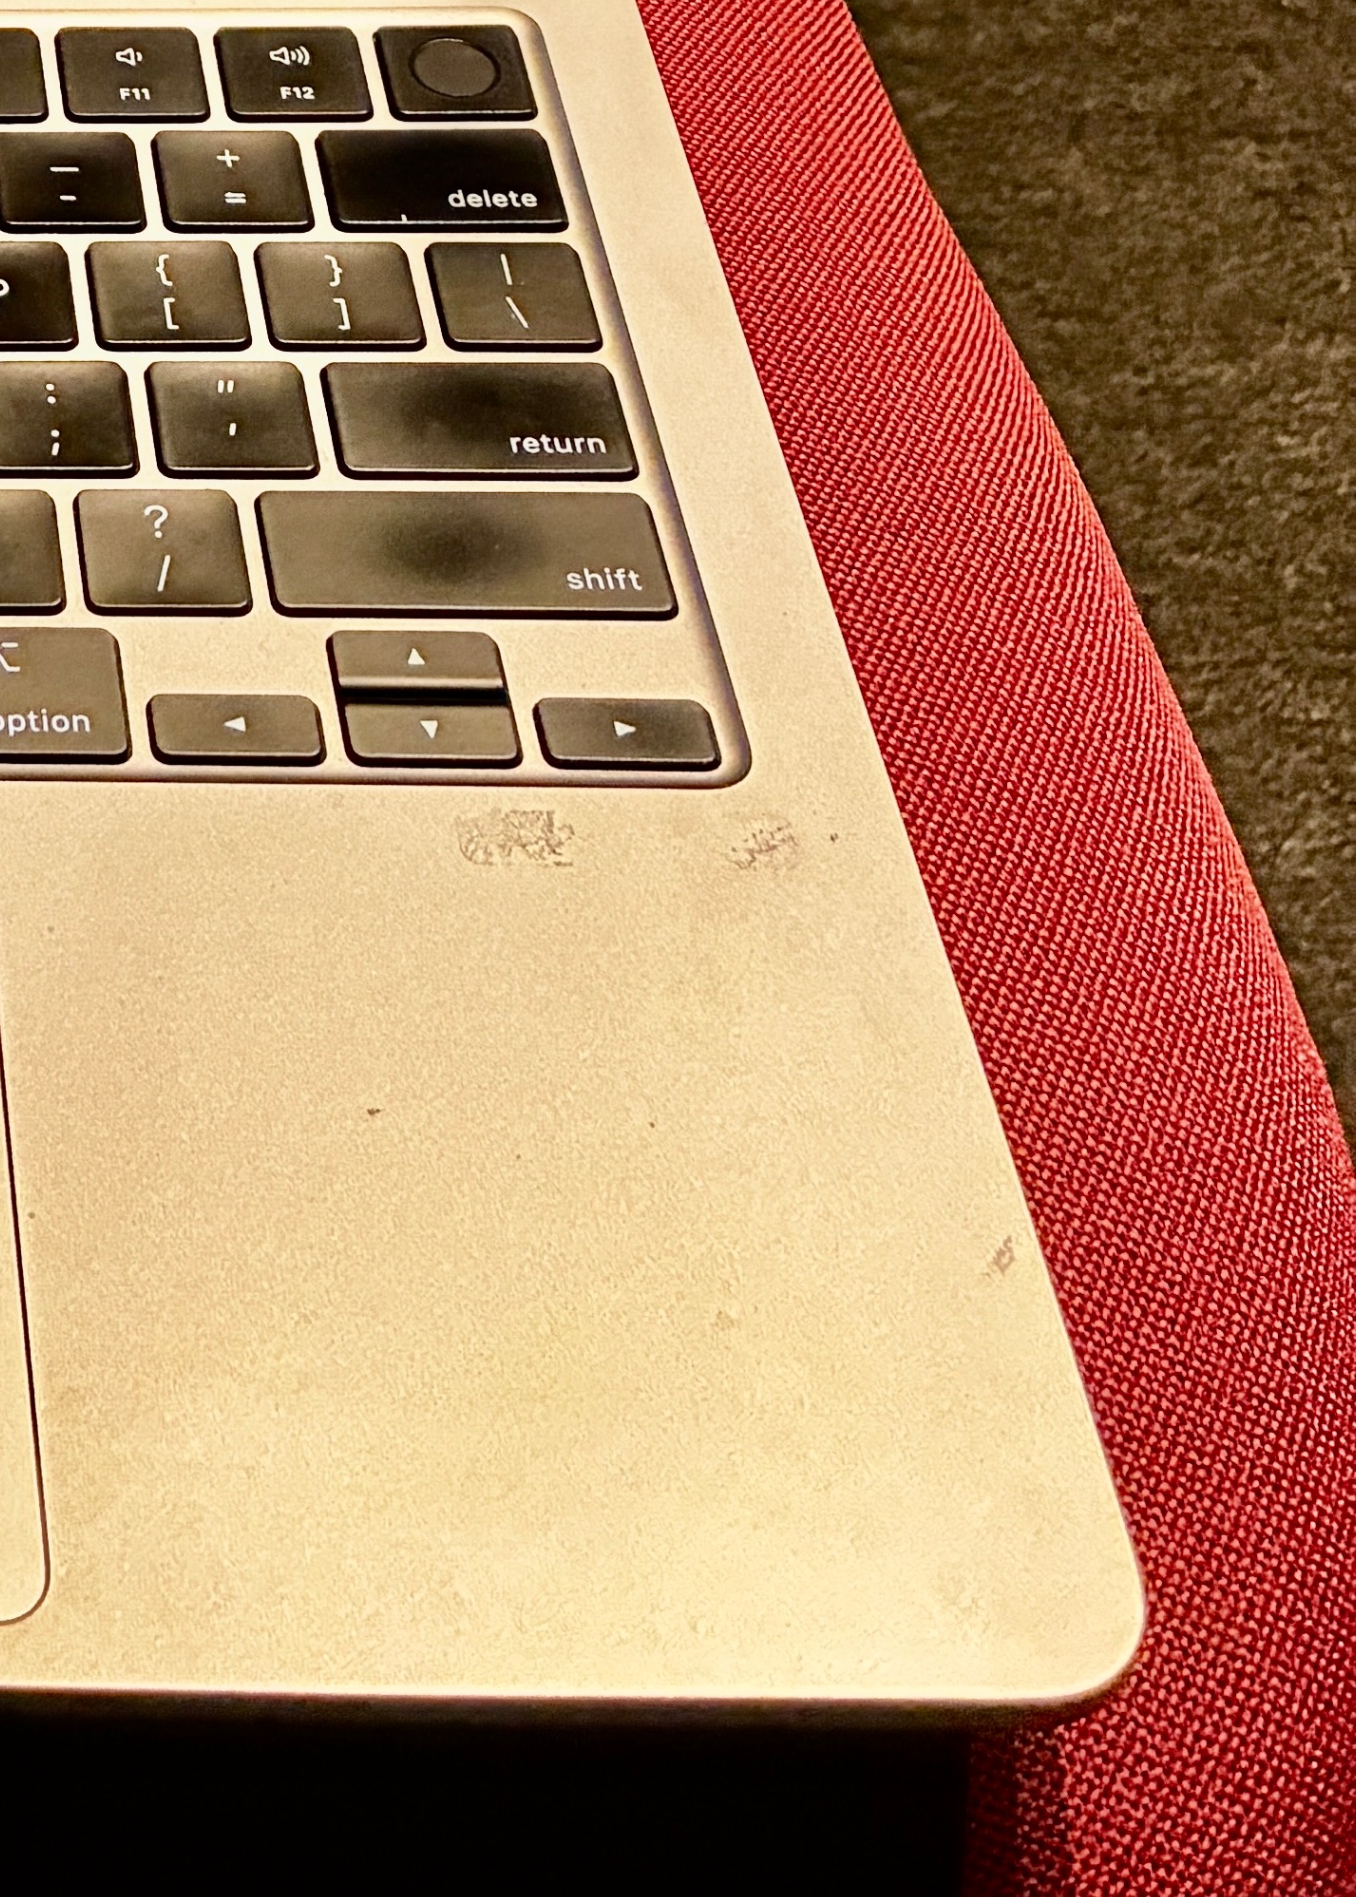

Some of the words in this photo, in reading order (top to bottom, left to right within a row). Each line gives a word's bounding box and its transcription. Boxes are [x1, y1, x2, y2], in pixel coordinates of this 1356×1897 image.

[448, 189, 538, 208] delete
[509, 434, 607, 454] return
[566, 567, 643, 591] shift
